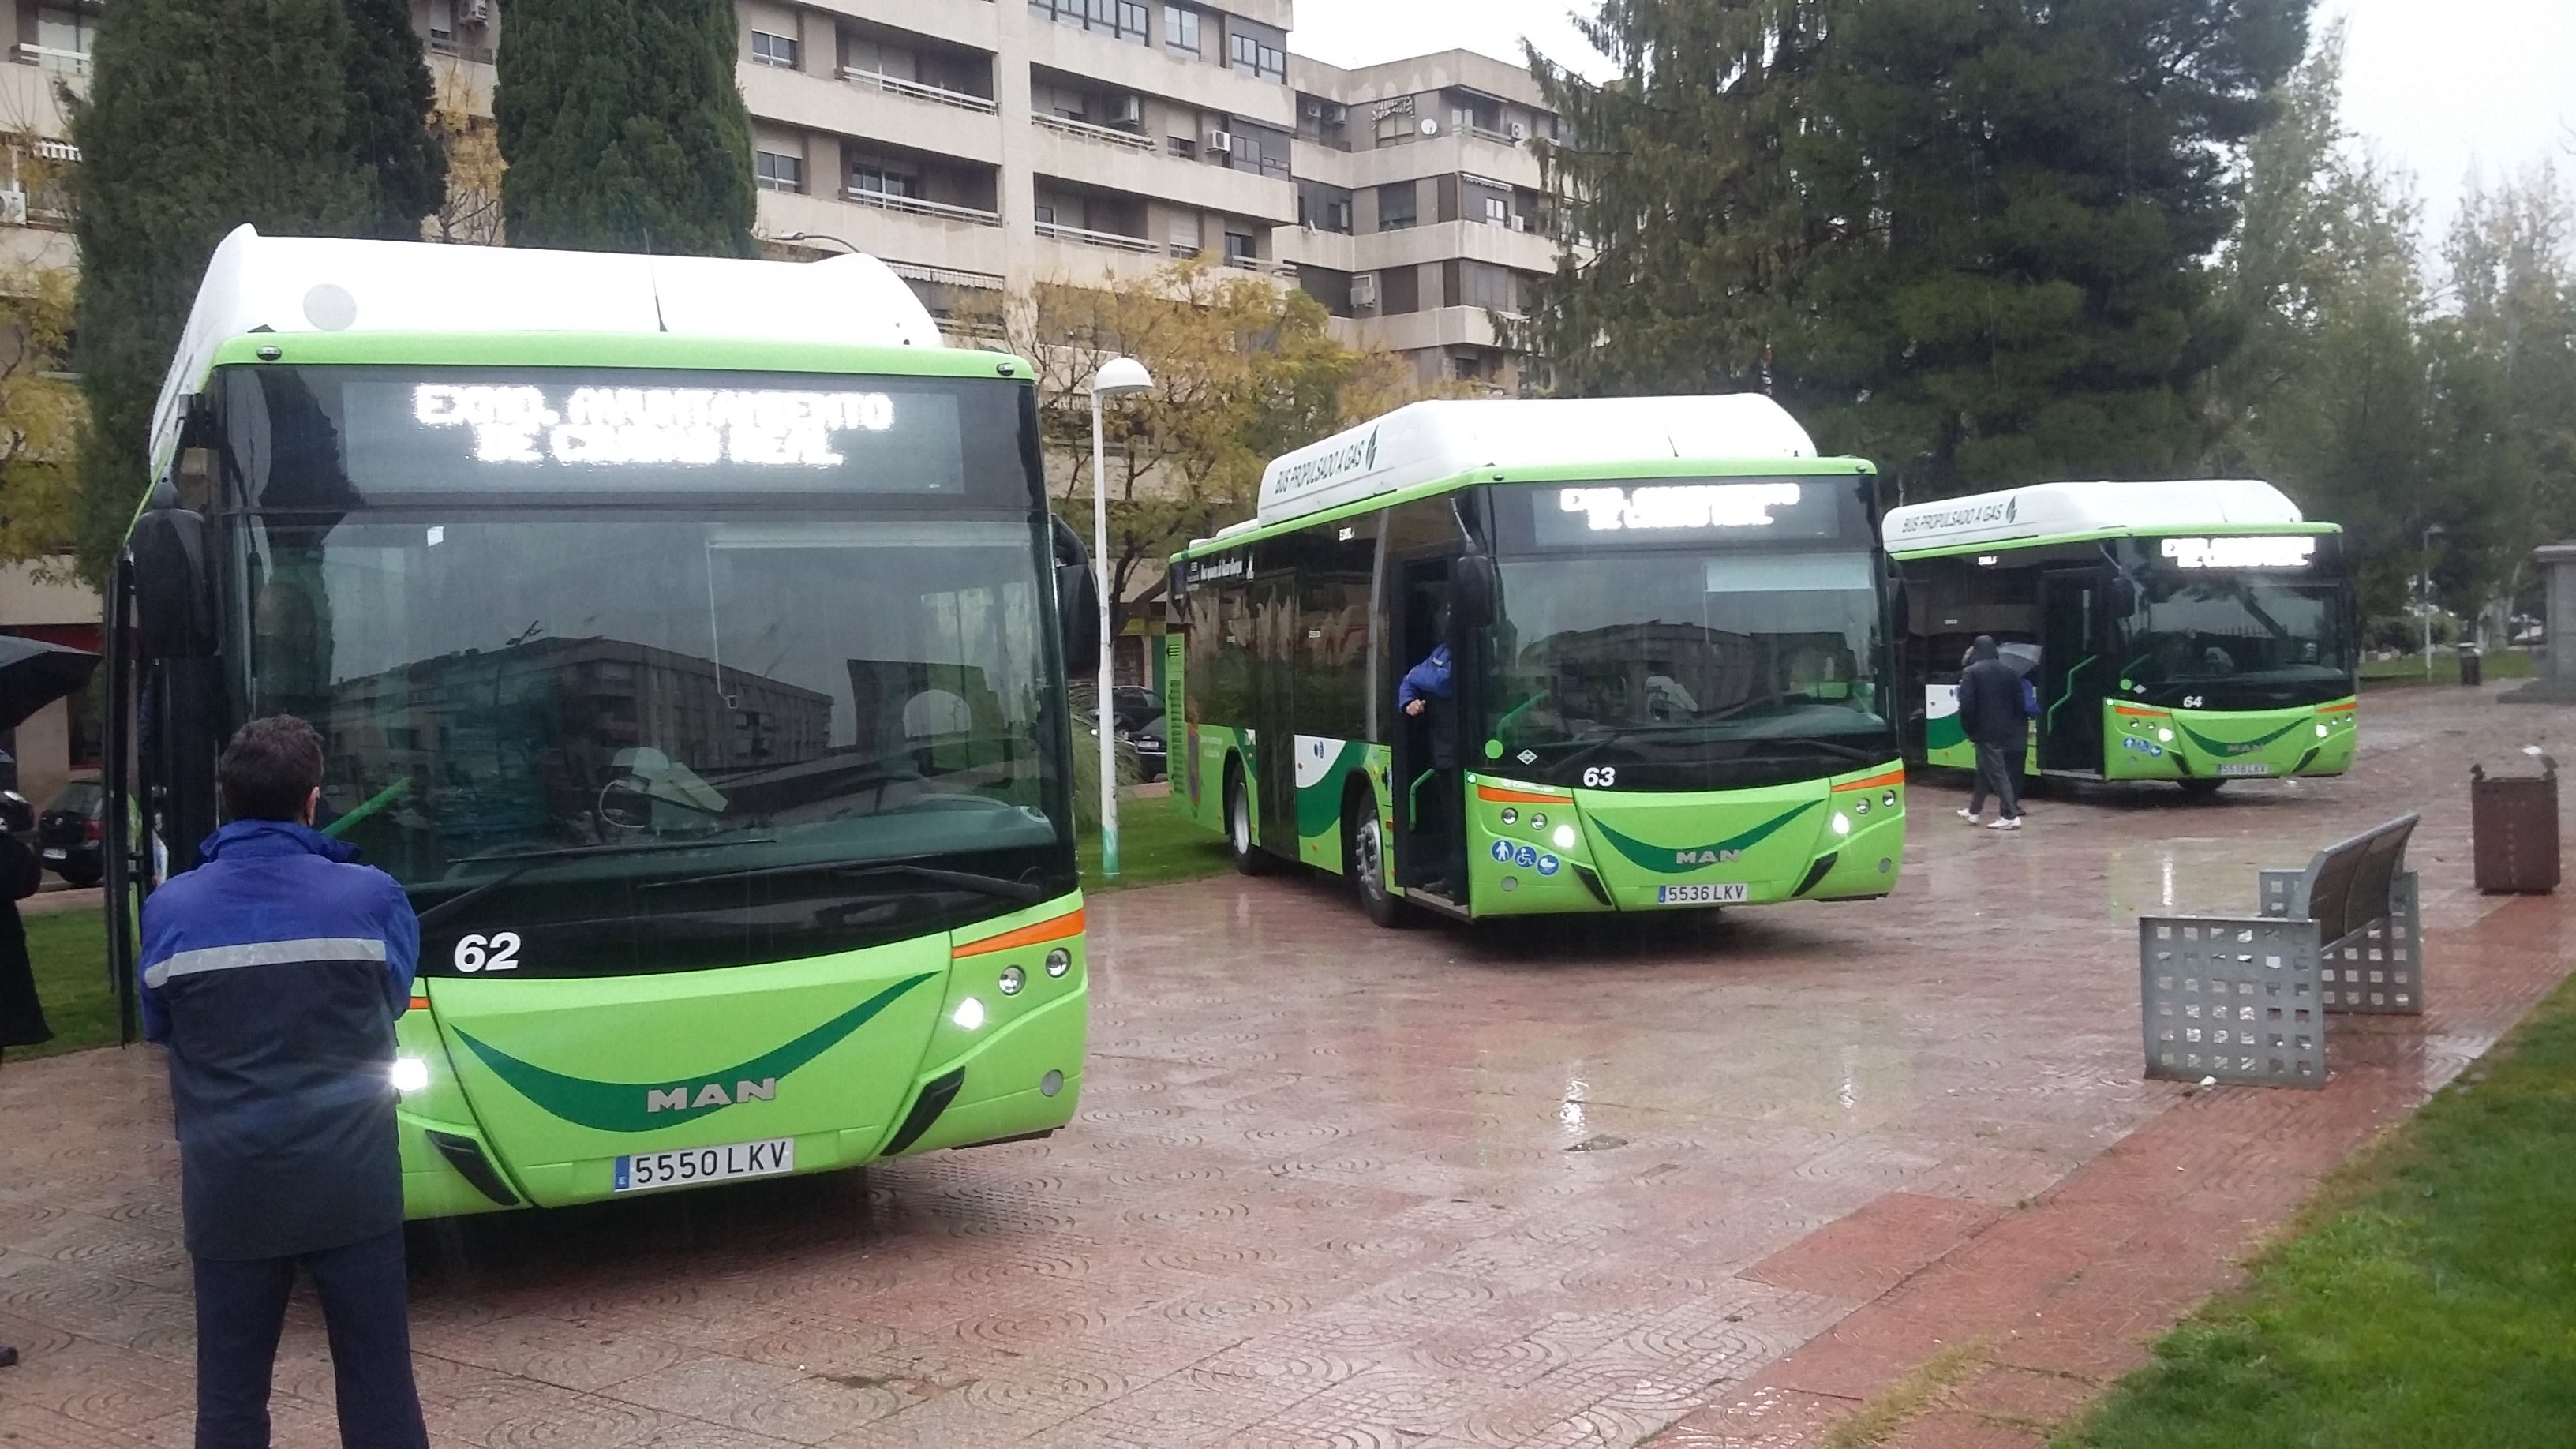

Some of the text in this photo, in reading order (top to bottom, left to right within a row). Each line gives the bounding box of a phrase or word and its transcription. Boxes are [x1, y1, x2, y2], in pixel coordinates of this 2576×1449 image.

[1275, 468, 1291, 494] BUS
[1289, 451, 1339, 489] PROPULSADO
[1344, 440, 1365, 472] GAS
[1902, 516, 1919, 533] BUS
[1983, 504, 2003, 522] GAS
[2183, 695, 2203, 708] 64
[1582, 766, 1616, 787] 63
[1676, 849, 1741, 865] MAN
[1668, 885, 1744, 901] 5536 LKV
[454, 931, 521, 973] 62
[647, 1077, 776, 1113] MAN
[635, 1141, 787, 1184] 5550 LKV
